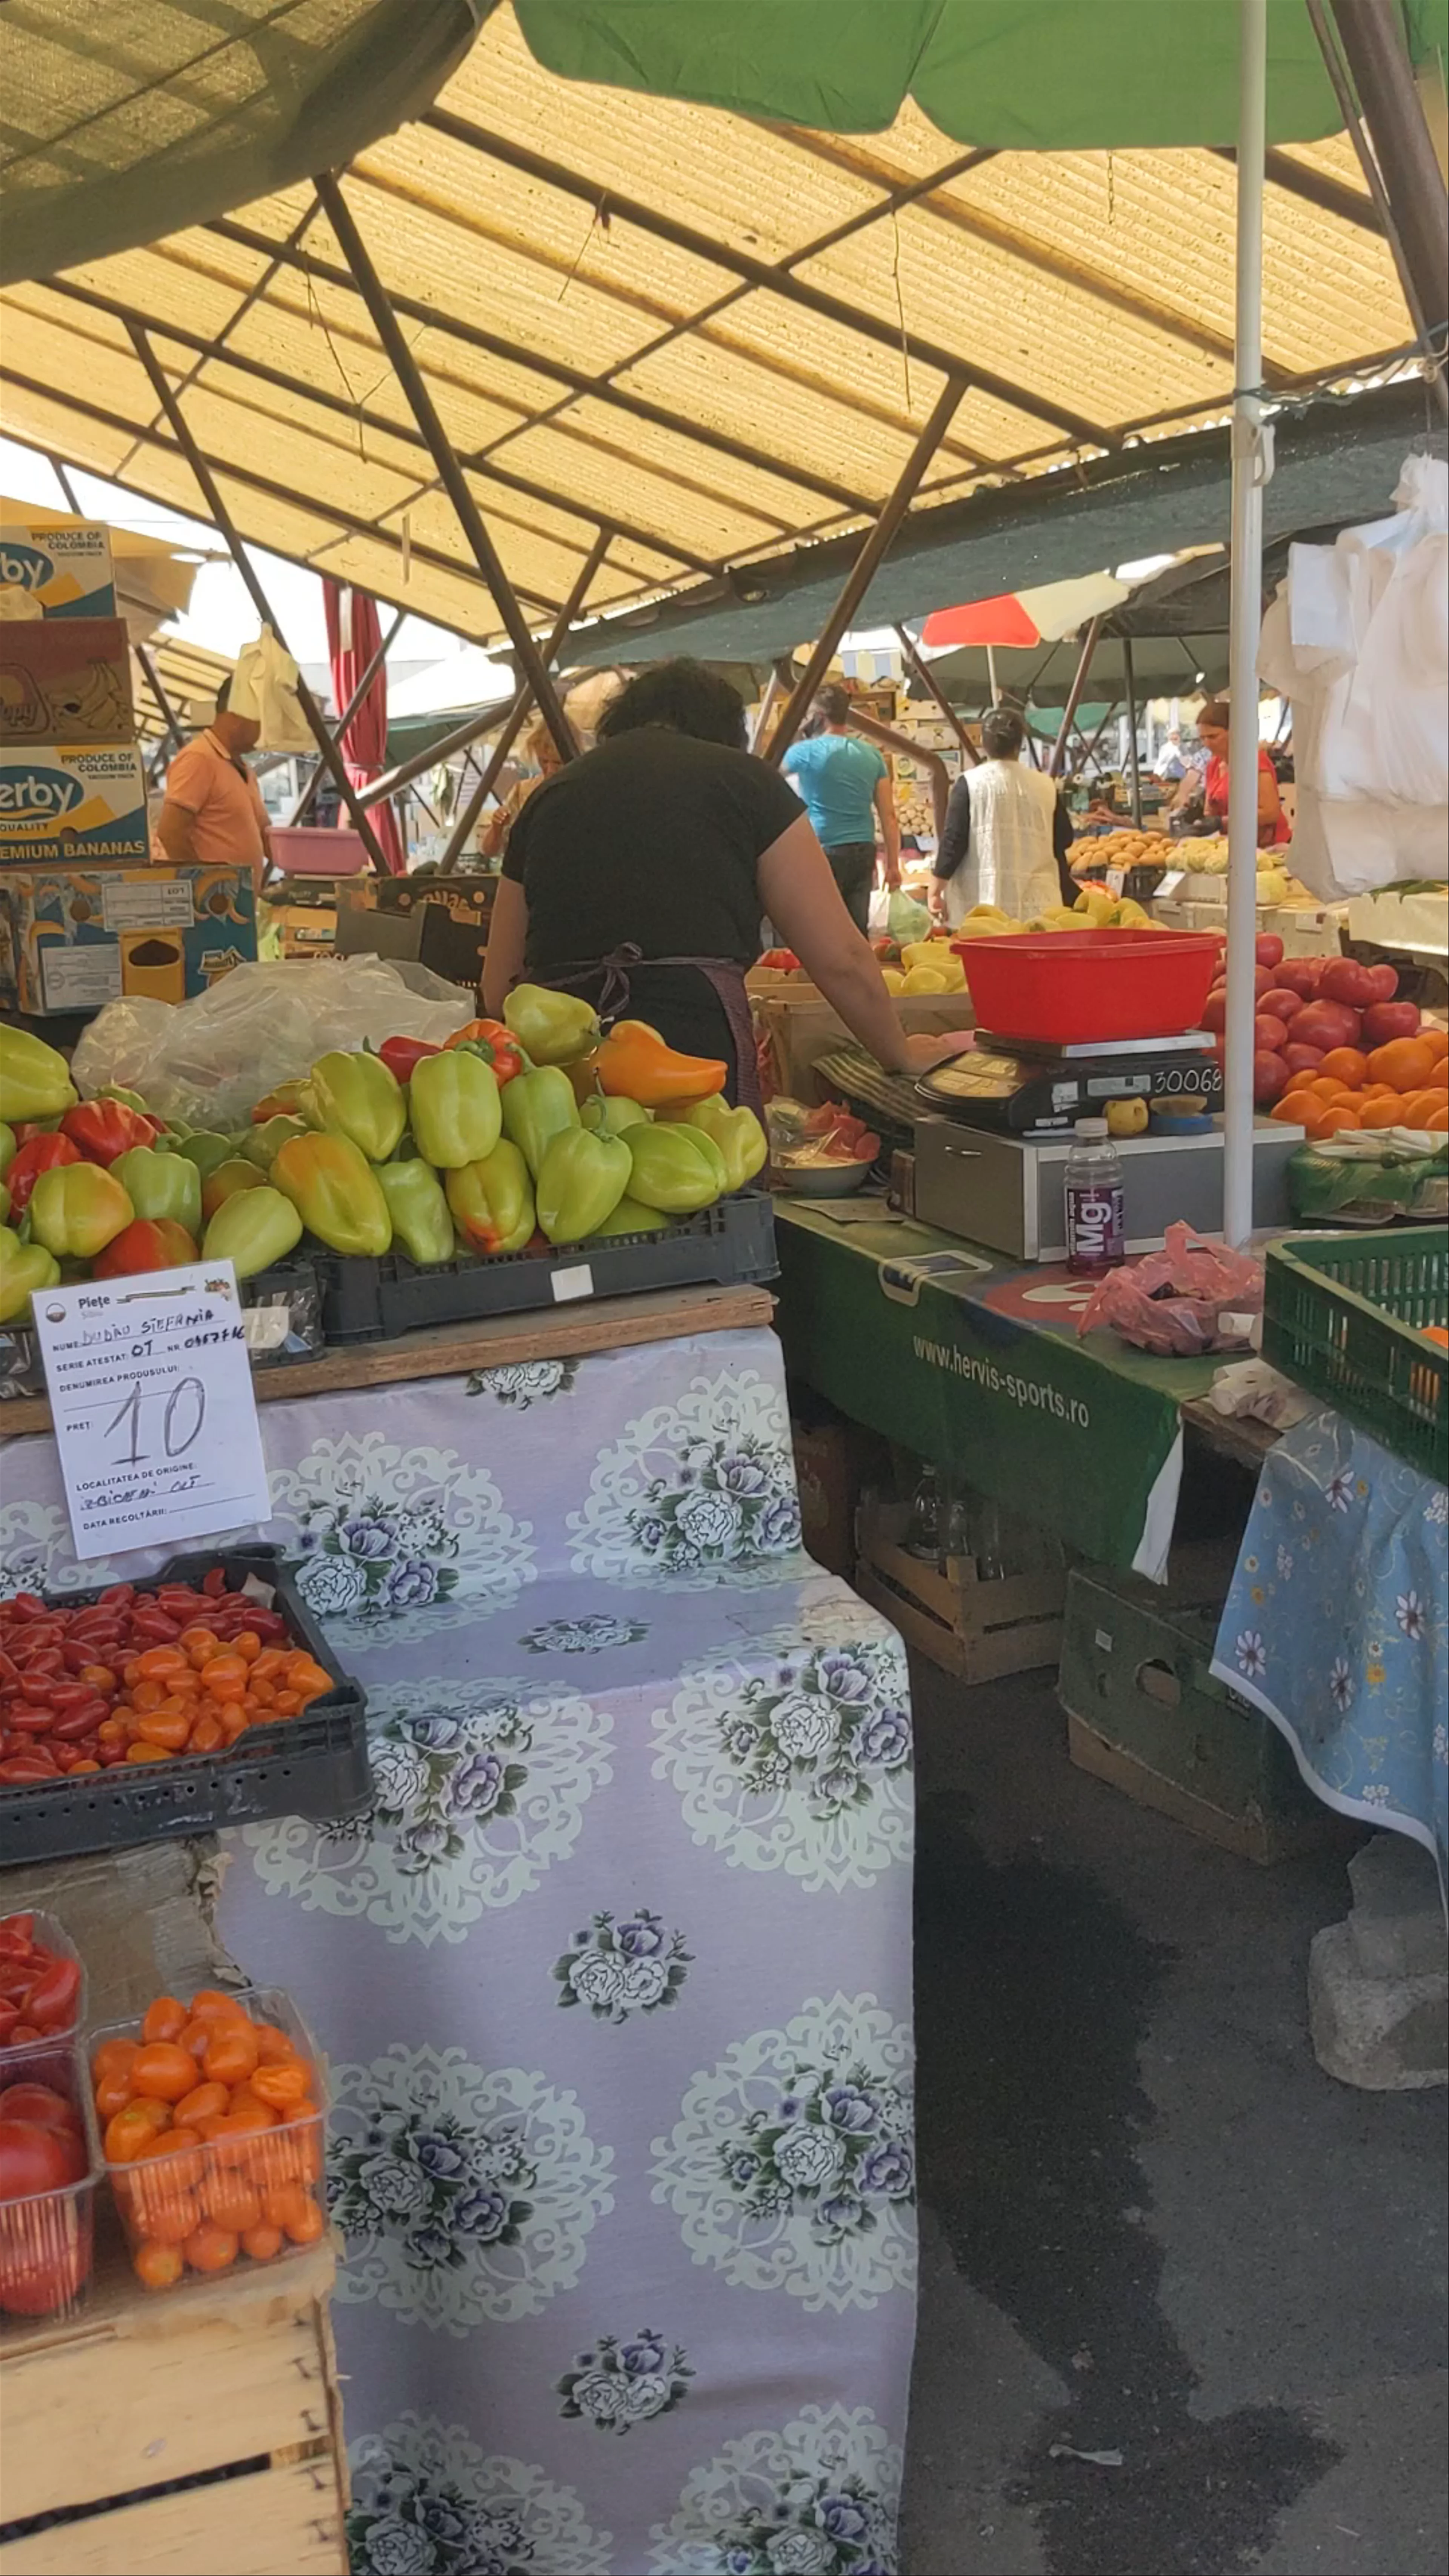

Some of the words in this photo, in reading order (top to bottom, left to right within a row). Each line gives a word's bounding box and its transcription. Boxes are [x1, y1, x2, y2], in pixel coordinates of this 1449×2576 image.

[32, 532, 83, 541] PRODUCE
[86, 531, 102, 540] OF
[48, 541, 105, 550] COLOMBIA
[61, 753, 115, 764] PRODUCE
[118, 753, 133, 762] OF
[78, 763, 137, 773] COLOMBIA
[63, 840, 145, 858] BANANAS
[56, 1361, 84, 1372] SERIE
[59, 1376, 114, 1392] DENUMIREA
[912, 1335, 1090, 1428] www.hervis-sports.ro
[104, 1376, 205, 1468] 10
[76, 1473, 140, 1492] LOCALITATEA
[142, 1469, 153, 1479] DE
[83, 1519, 107, 1530] DATA
